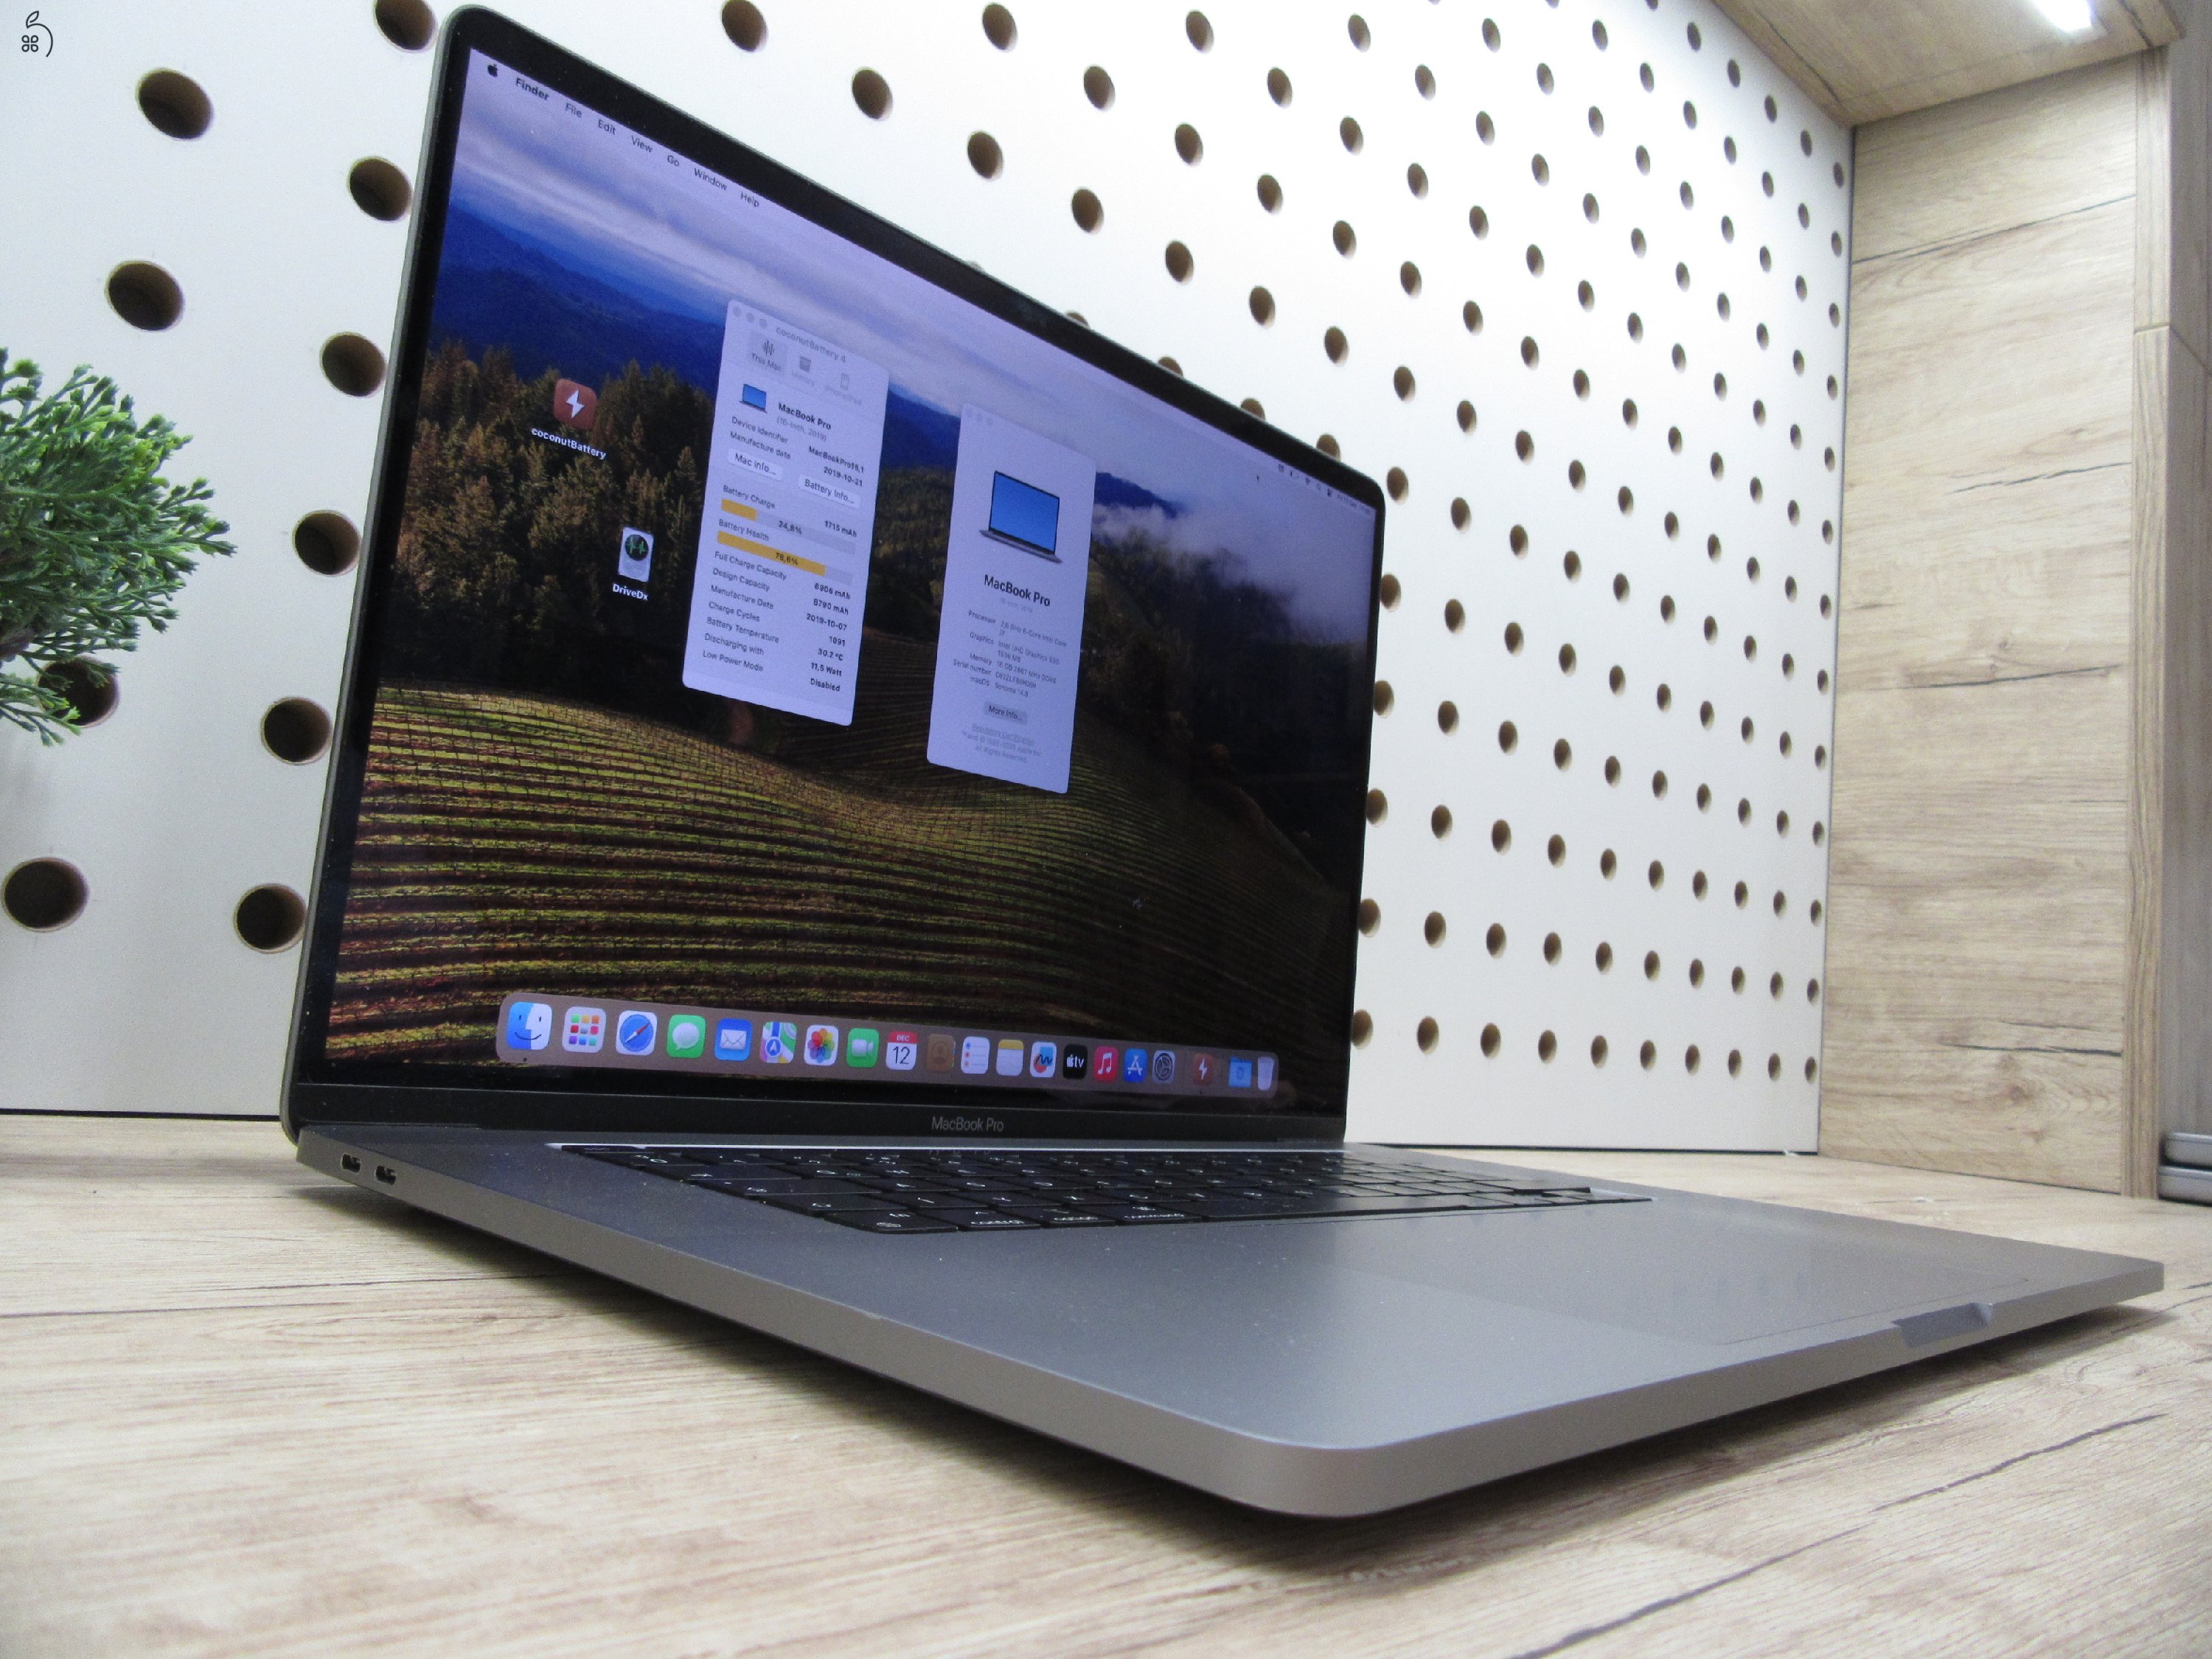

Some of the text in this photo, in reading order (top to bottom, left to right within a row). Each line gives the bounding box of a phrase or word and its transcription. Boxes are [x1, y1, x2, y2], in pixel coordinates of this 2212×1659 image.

[515, 77, 759, 208] Finder File Edit View Go Window Help
[776, 327, 838, 362] coconutBattery
[778, 403, 832, 431] MacBook Pro
[731, 416, 788, 444] Device Identifier
[531, 426, 607, 461] coconutBattery
[730, 431, 791, 459] Manufacture date
[735, 453, 752, 467] Mac
[824, 466, 863, 487] 2019-10-21
[723, 484, 776, 509] Battery Charge
[804, 479, 832, 496] Battery
[719, 519, 769, 541] Battery Health
[779, 521, 802, 535] 24,8%
[824, 520, 858, 538] 1715 mAh
[714, 552, 787, 581] Full Charge Capacity
[713, 568, 770, 592] Design Capacity
[612, 582, 649, 602] DriveDx
[711, 585, 773, 610] Manufacture Date
[814, 582, 850, 600] 6906 mAh
[984, 574, 1031, 600] MacBook
[1033, 591, 1051, 607] Pro
[709, 602, 760, 622] Charge Cycles
[833, 605, 849, 616] mAh
[968, 610, 996, 625] Processor
[707, 616, 779, 644] Battery Temperature
[807, 613, 847, 630] 2019-10-07
[704, 633, 764, 655] Discharging with
[829, 636, 846, 647] 1091
[970, 632, 994, 644] Graphics
[1054, 638, 1067, 647] Core
[703, 650, 763, 672] Low Power Mode
[953, 659, 991, 675] Serial number
[970, 653, 992, 667] Memory
[826, 667, 842, 677] Watt
[970, 676, 990, 686] macOS
[810, 678, 841, 692] Disabled
[995, 683, 1016, 694] Sonoma
[989, 706, 1005, 716] More
[896, 1034, 910, 1042] DEC
[892, 1046, 911, 1065] 12
[1073, 1055, 1084, 1068] tv
[931, 1116, 1004, 1132] MacBook Pro
